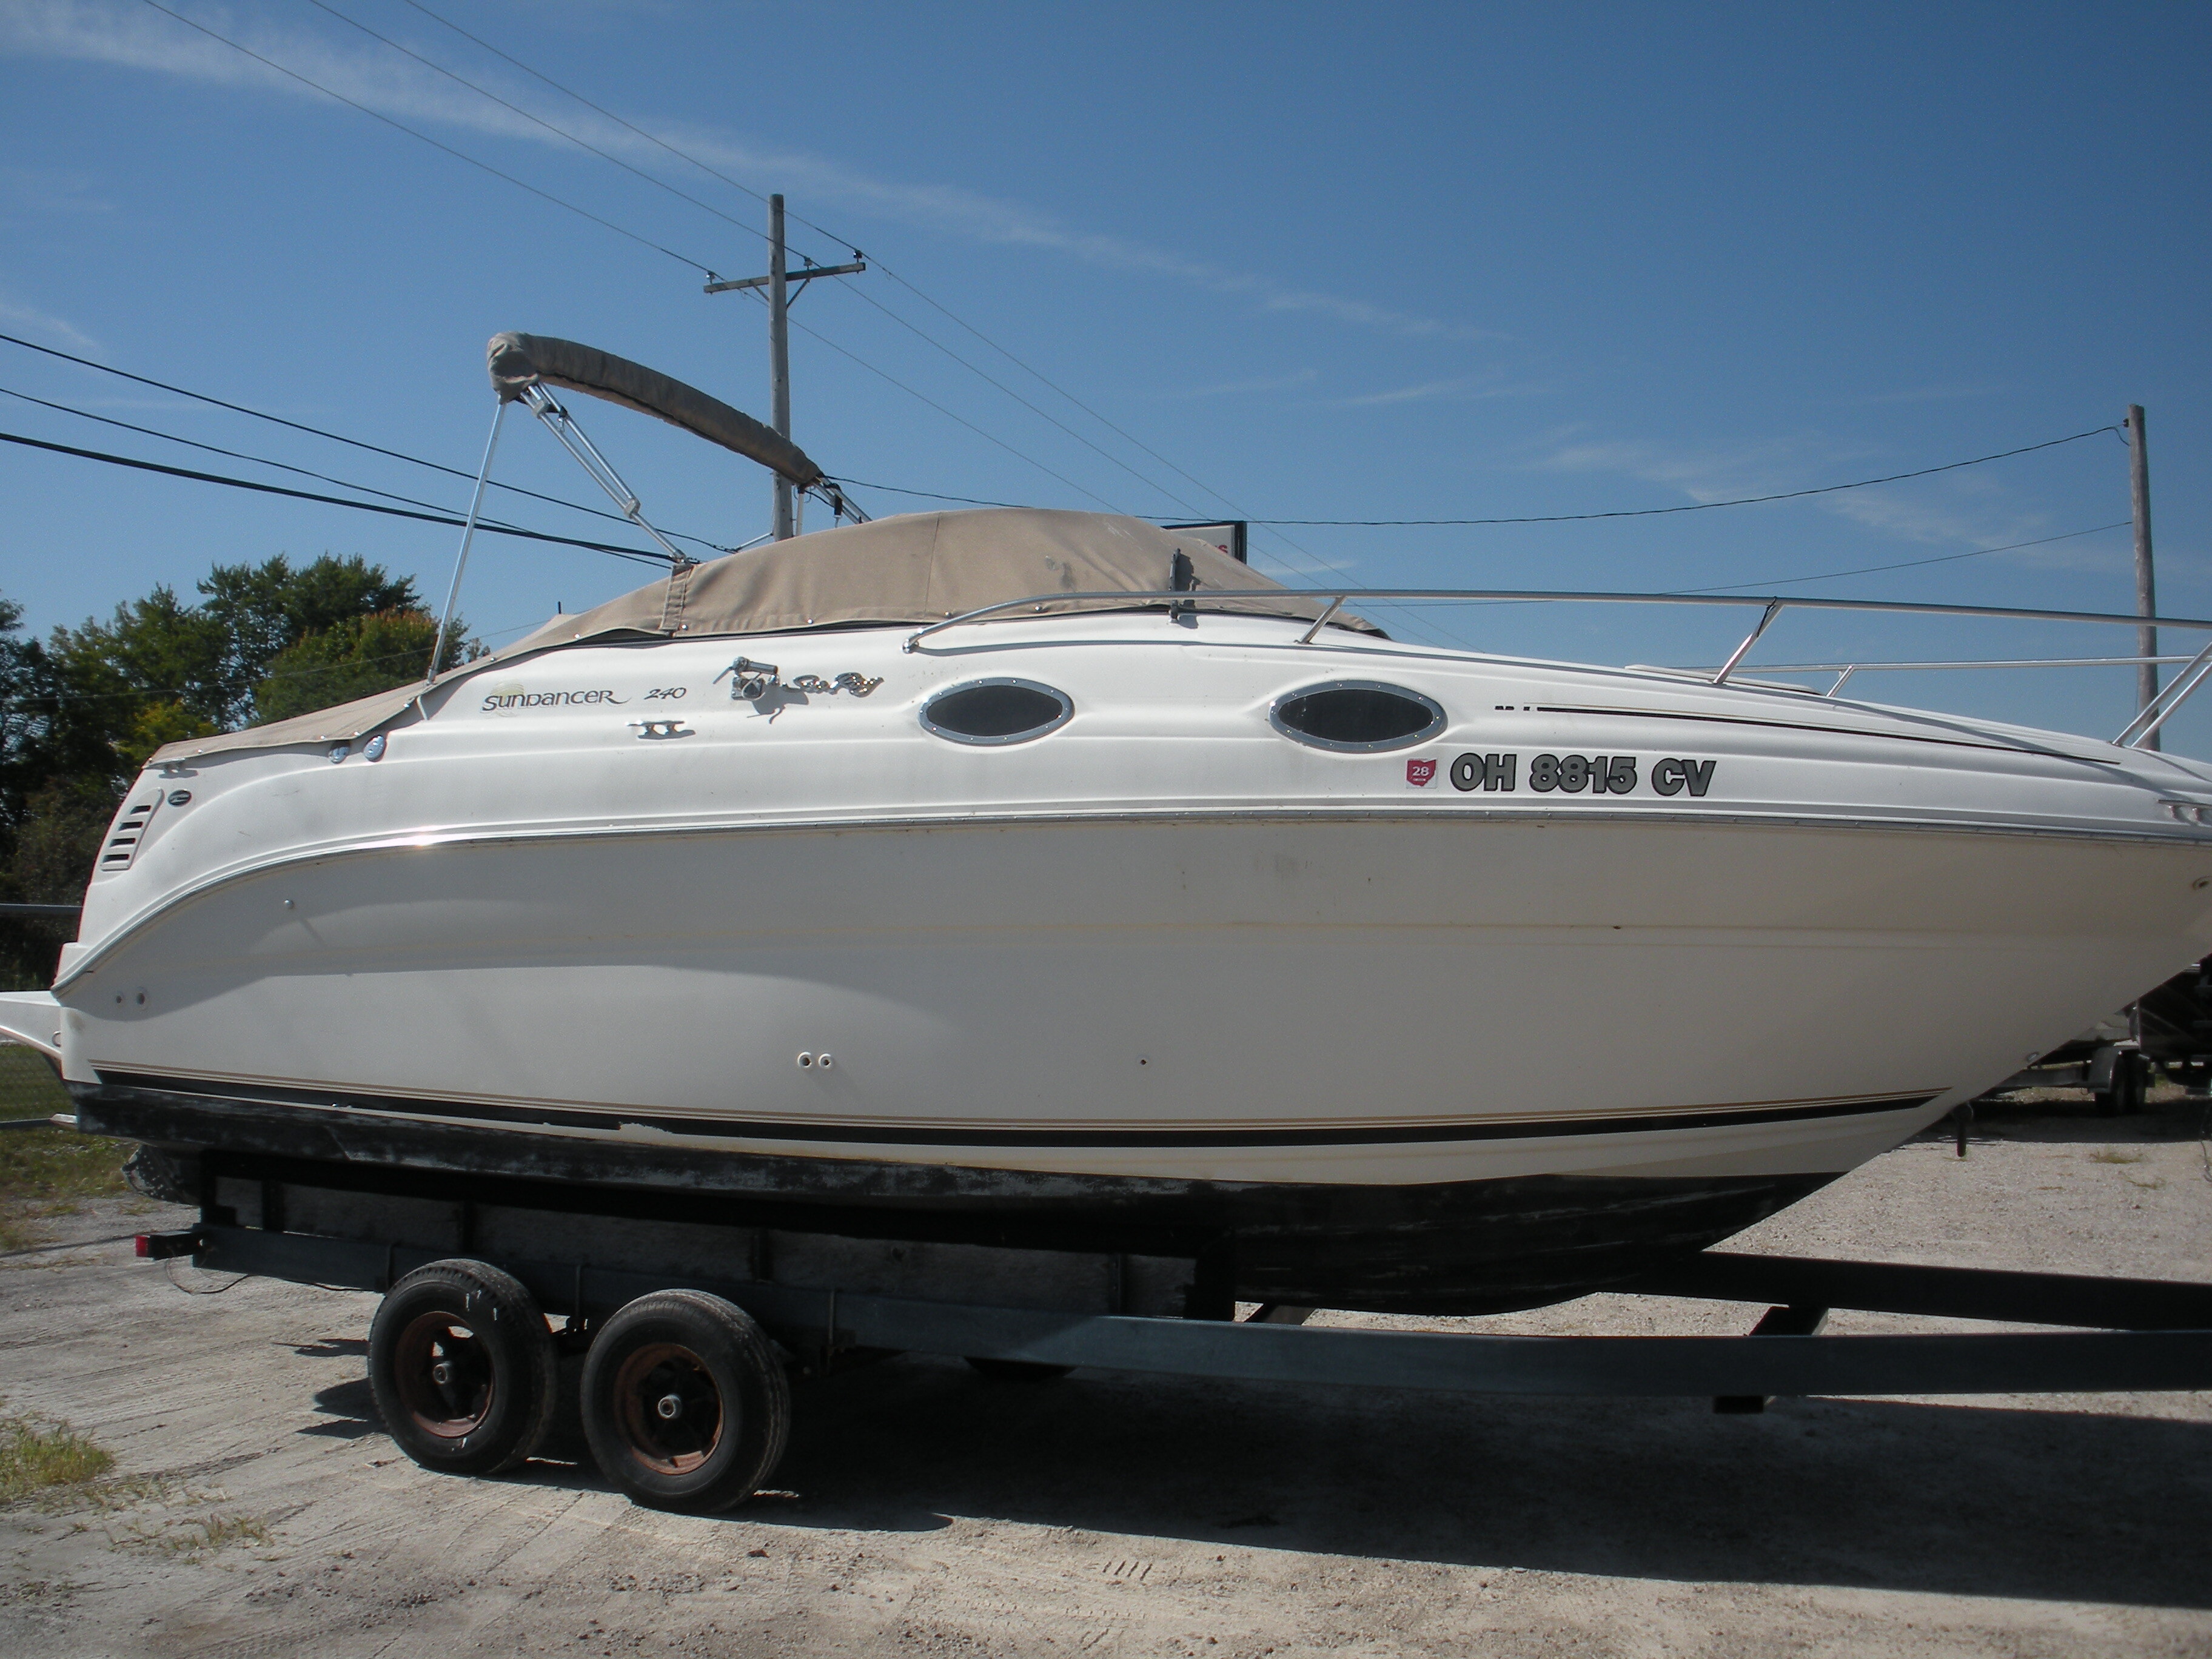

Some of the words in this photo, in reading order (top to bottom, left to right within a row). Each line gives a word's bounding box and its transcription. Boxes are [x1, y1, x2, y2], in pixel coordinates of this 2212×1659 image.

[645, 688, 686, 700] 240
[1412, 766, 1429, 776] 28
[1450, 752, 1517, 791] OH
[1529, 754, 1637, 794] 8815
[1651, 758, 1717, 797] CV
